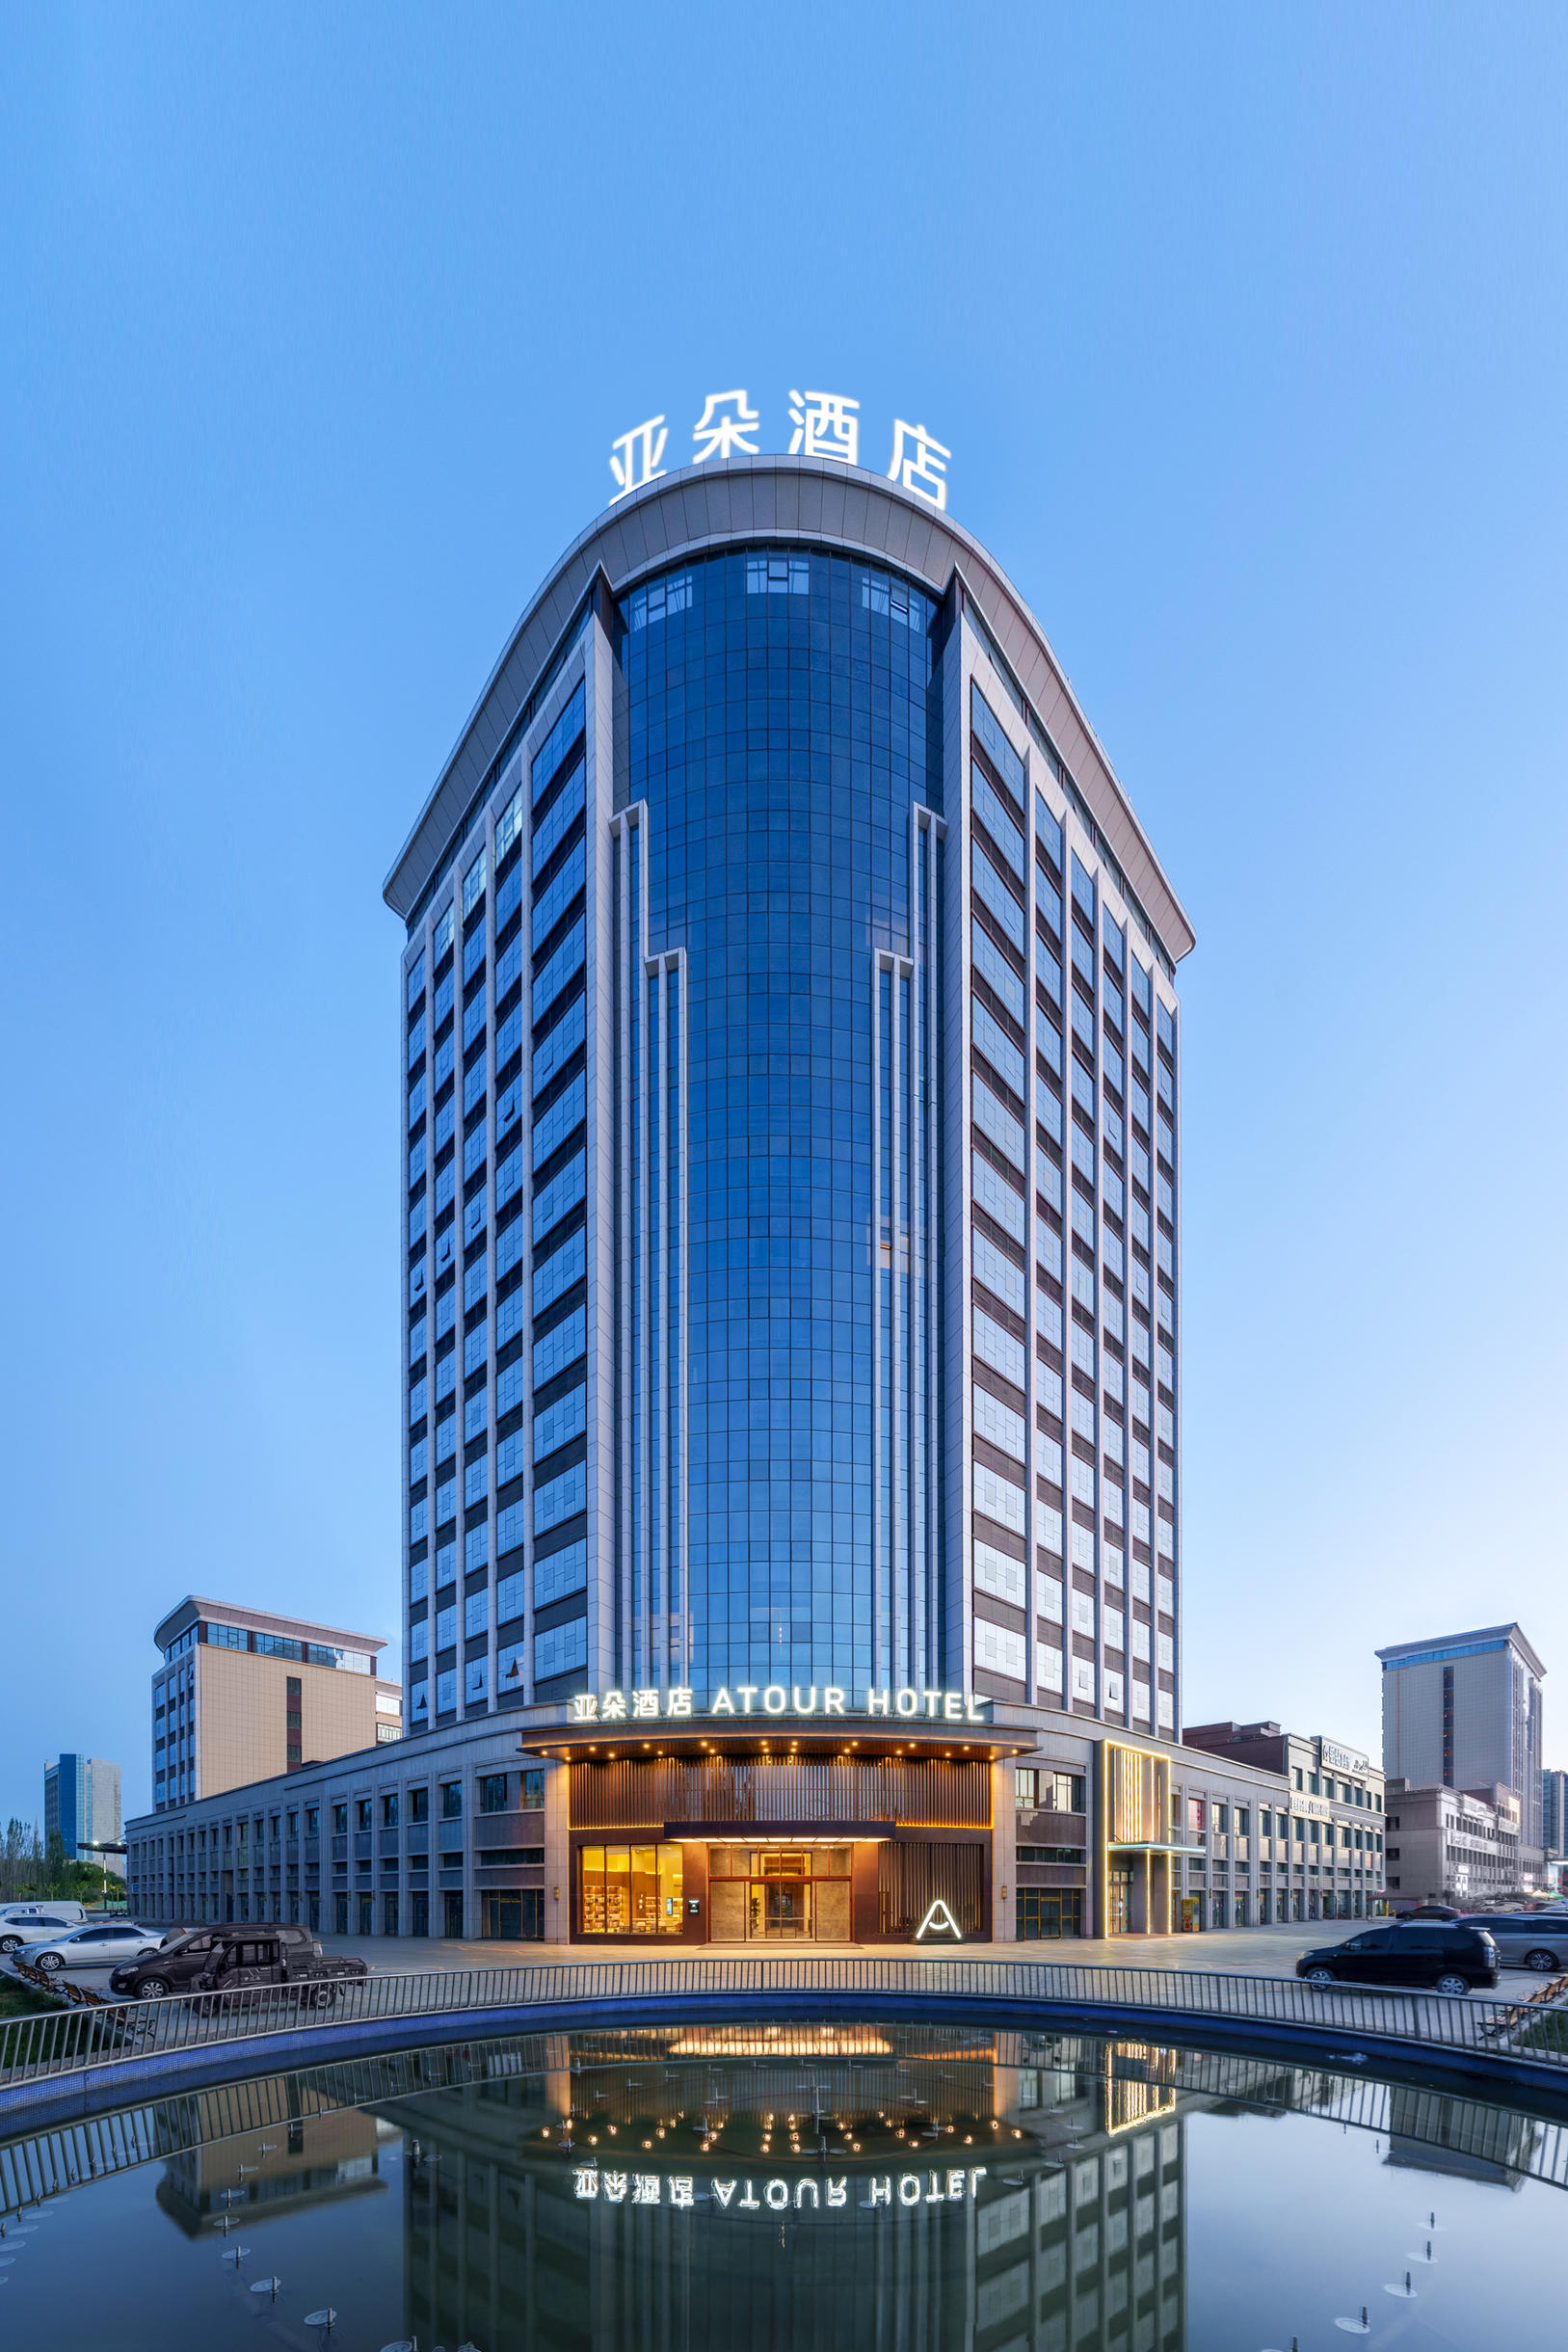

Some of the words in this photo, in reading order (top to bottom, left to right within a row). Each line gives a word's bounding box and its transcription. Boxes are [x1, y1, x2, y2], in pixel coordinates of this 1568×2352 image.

[610, 390, 951, 510] 亚朵酒店
[573, 1687, 693, 1721] 亚朵酒店
[711, 1686, 845, 1714] ATOUR
[867, 1689, 985, 1721] HOTEL
